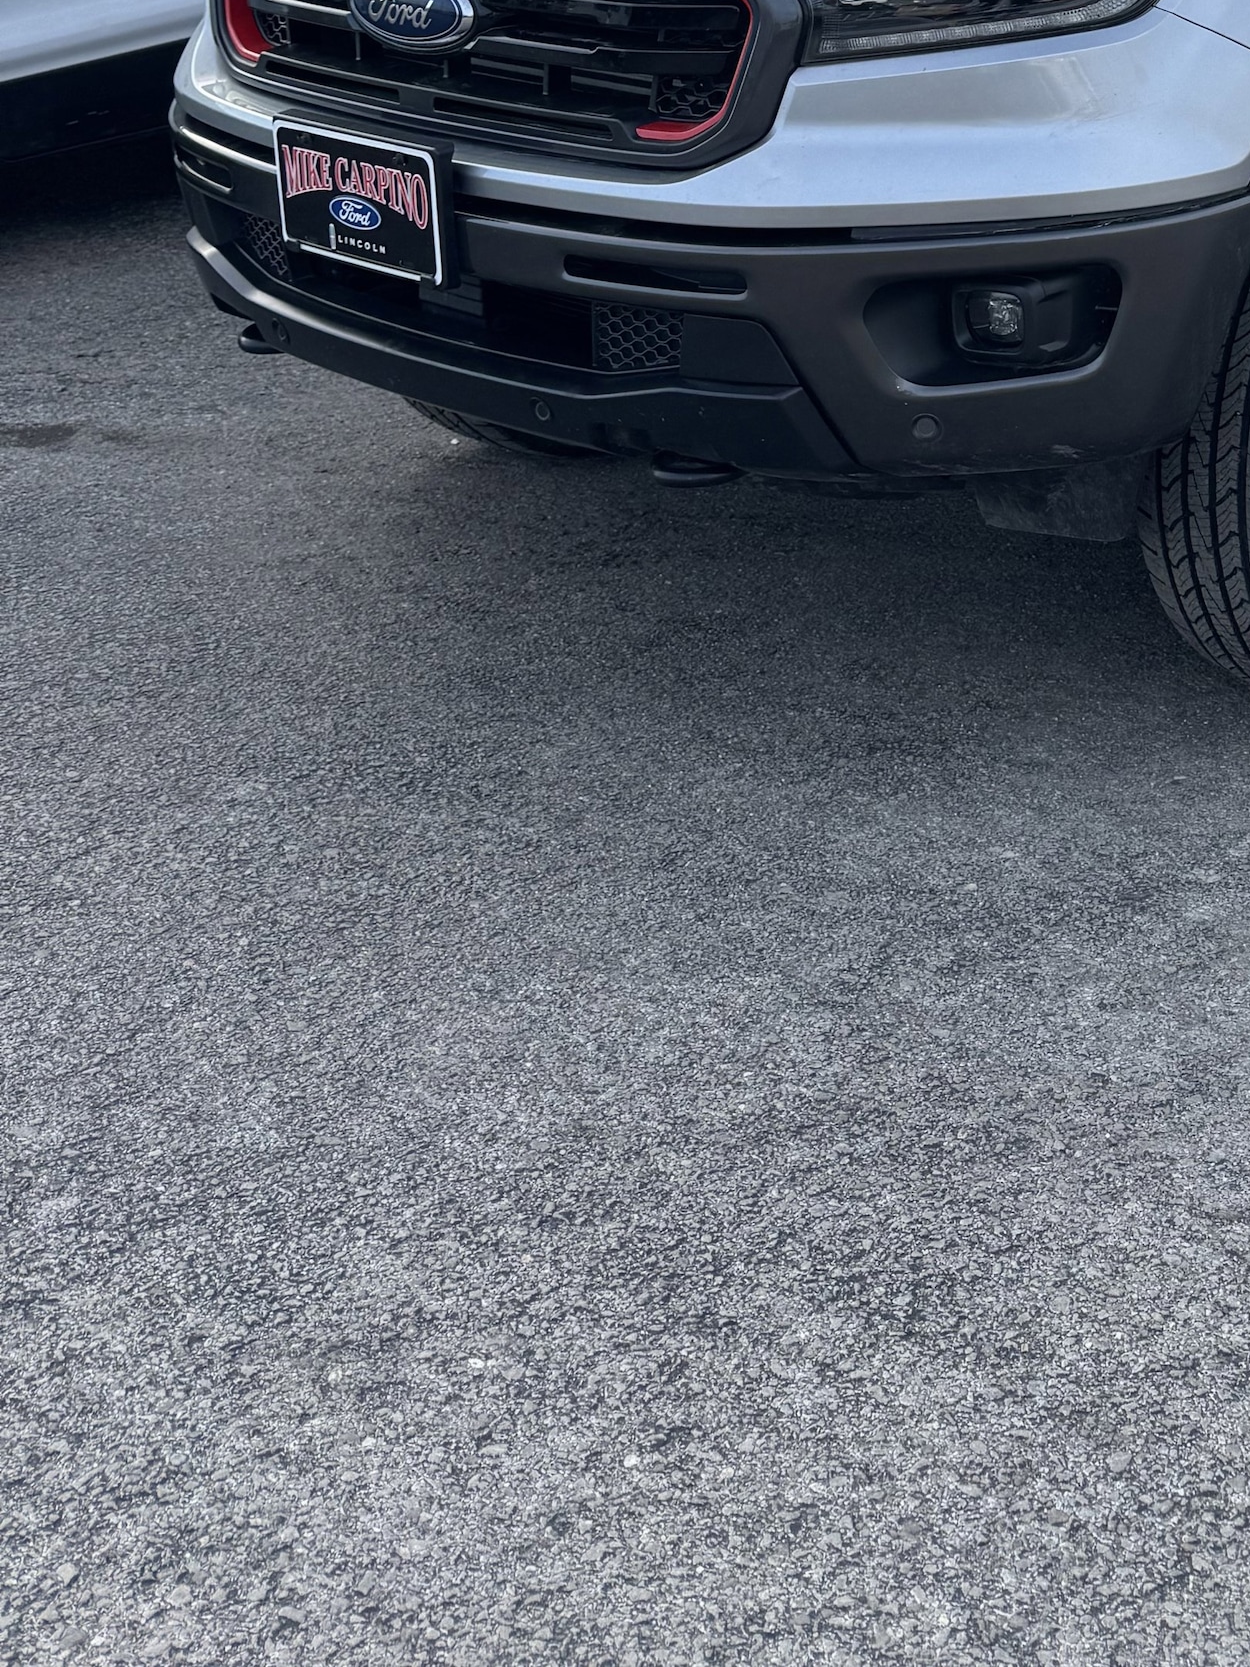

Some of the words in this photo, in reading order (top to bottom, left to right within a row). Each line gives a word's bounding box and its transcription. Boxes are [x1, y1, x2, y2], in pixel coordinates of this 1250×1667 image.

[281, 144, 333, 199] MIKE
[334, 157, 429, 230] CARPINO
[338, 200, 372, 226] Ford
[337, 235, 386, 254] LINCOLN
